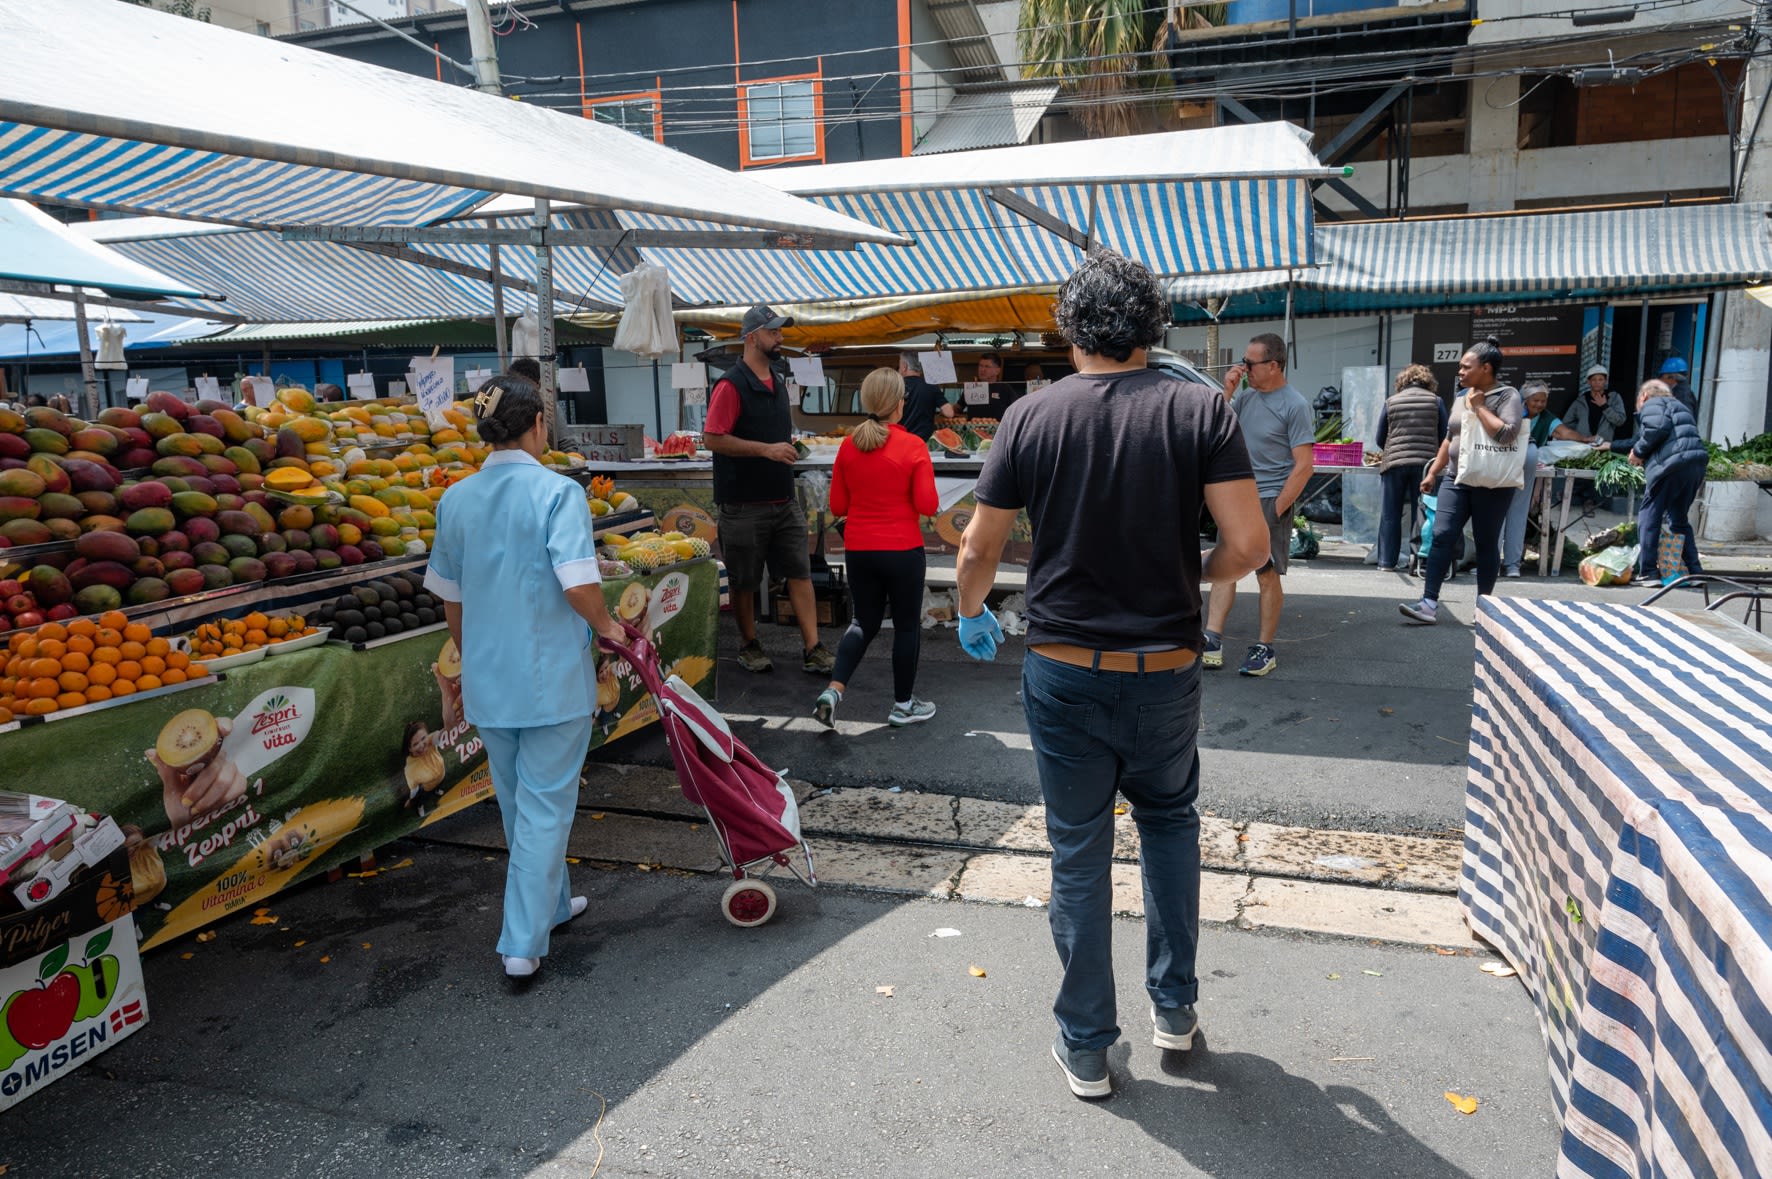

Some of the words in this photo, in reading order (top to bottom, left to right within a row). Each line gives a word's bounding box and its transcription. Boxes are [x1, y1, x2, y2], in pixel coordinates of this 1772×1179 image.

[1437, 350, 1459, 360] 277
[1474, 443, 1518, 453] mercerie
[656, 631, 662, 645] 1
[252, 704, 302, 735] Zespri
[263, 733, 297, 750] vita
[253, 777, 263, 796] 1
[183, 804, 262, 868] Zespri
[216, 870, 249, 893] 100%
[202, 880, 257, 911] Vitamina
[4, 910, 72, 952] Pilger
